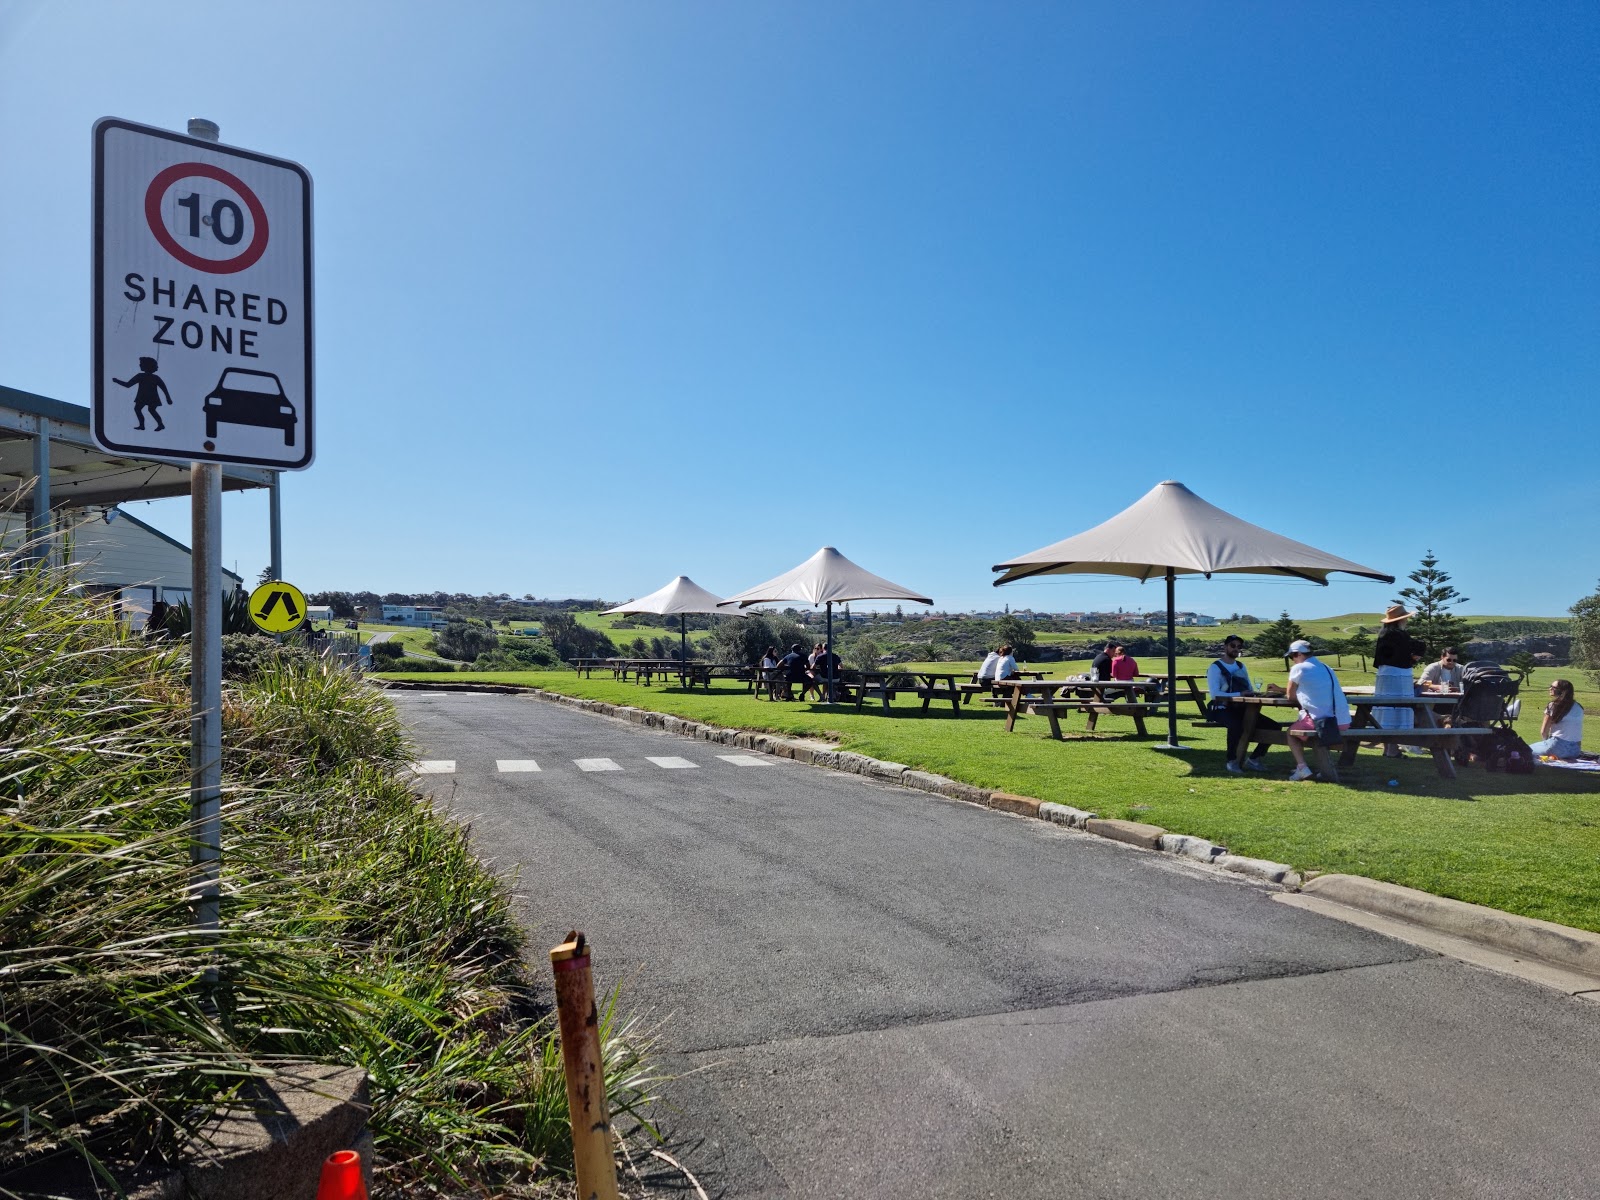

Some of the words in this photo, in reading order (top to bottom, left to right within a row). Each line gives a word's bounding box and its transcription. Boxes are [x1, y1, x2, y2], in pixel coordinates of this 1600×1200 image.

[178, 192, 245, 246] 10
[123, 272, 288, 326] SHARED
[152, 315, 260, 359] ZONE
